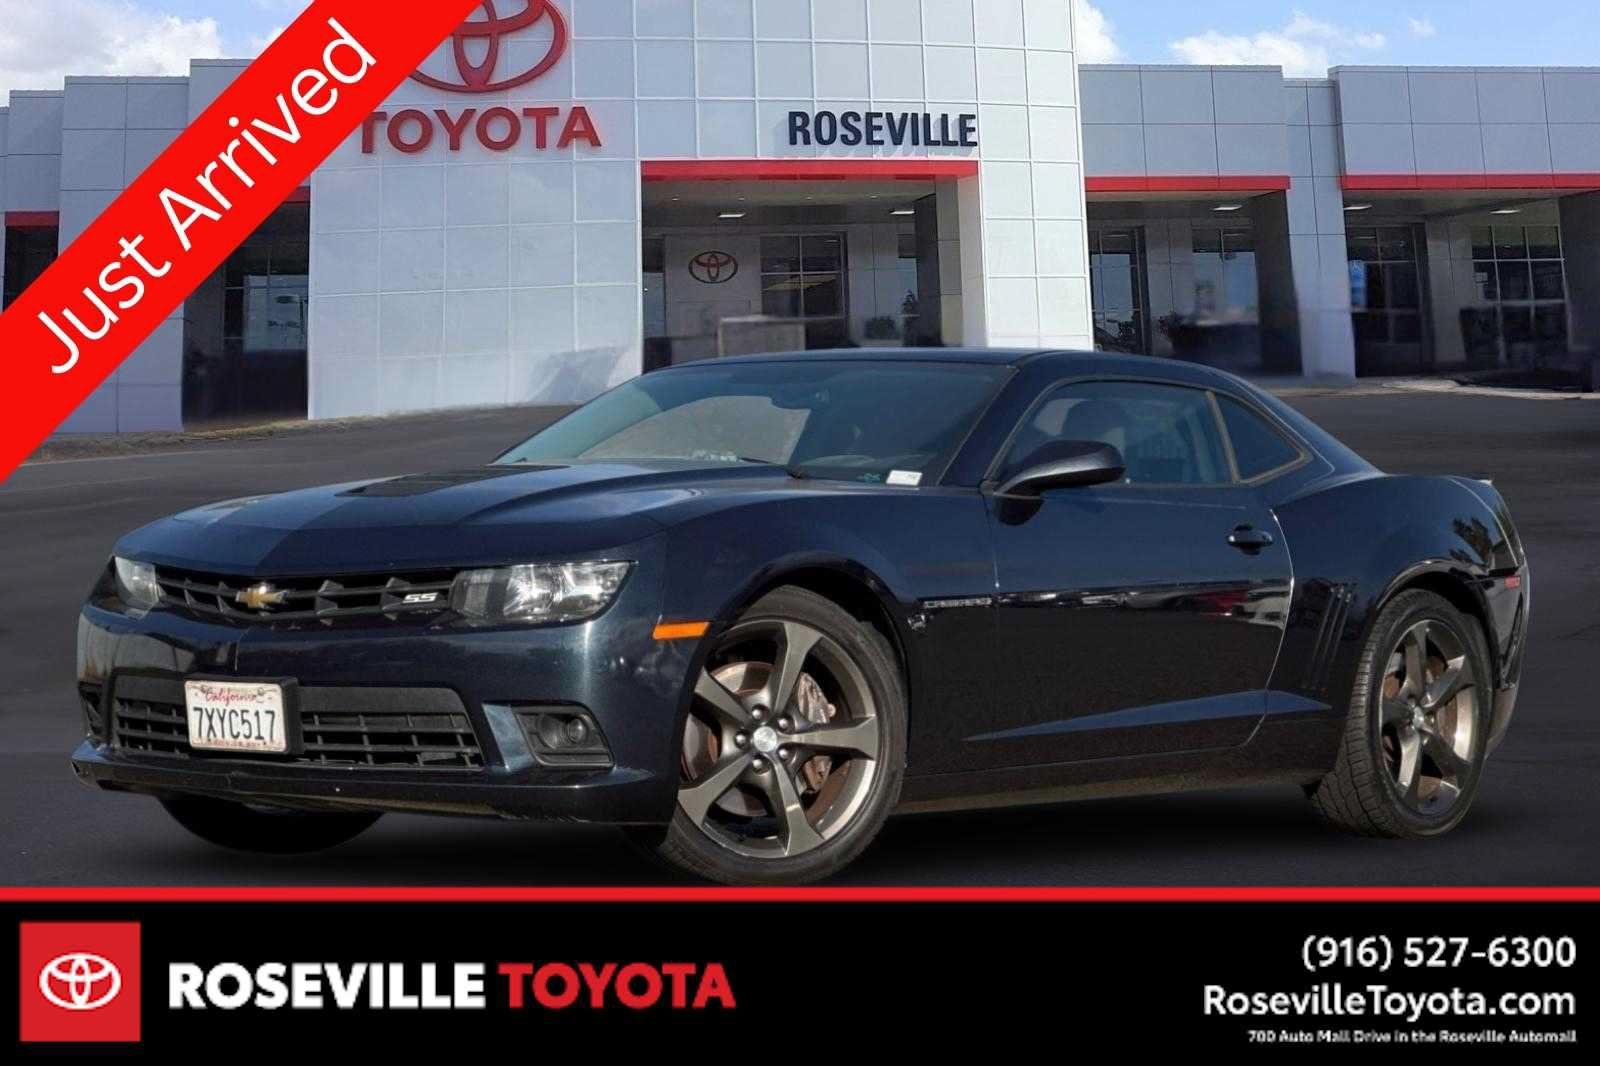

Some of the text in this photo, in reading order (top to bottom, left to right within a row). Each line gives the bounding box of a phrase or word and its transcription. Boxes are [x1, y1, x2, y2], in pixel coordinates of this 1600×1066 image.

[361, 106, 603, 154] TOYOTA
[788, 110, 978, 148] ROSEVILLE
[402, 592, 439, 604] SS
[205, 686, 258, 706] California
[193, 706, 276, 743] 7XYC517
